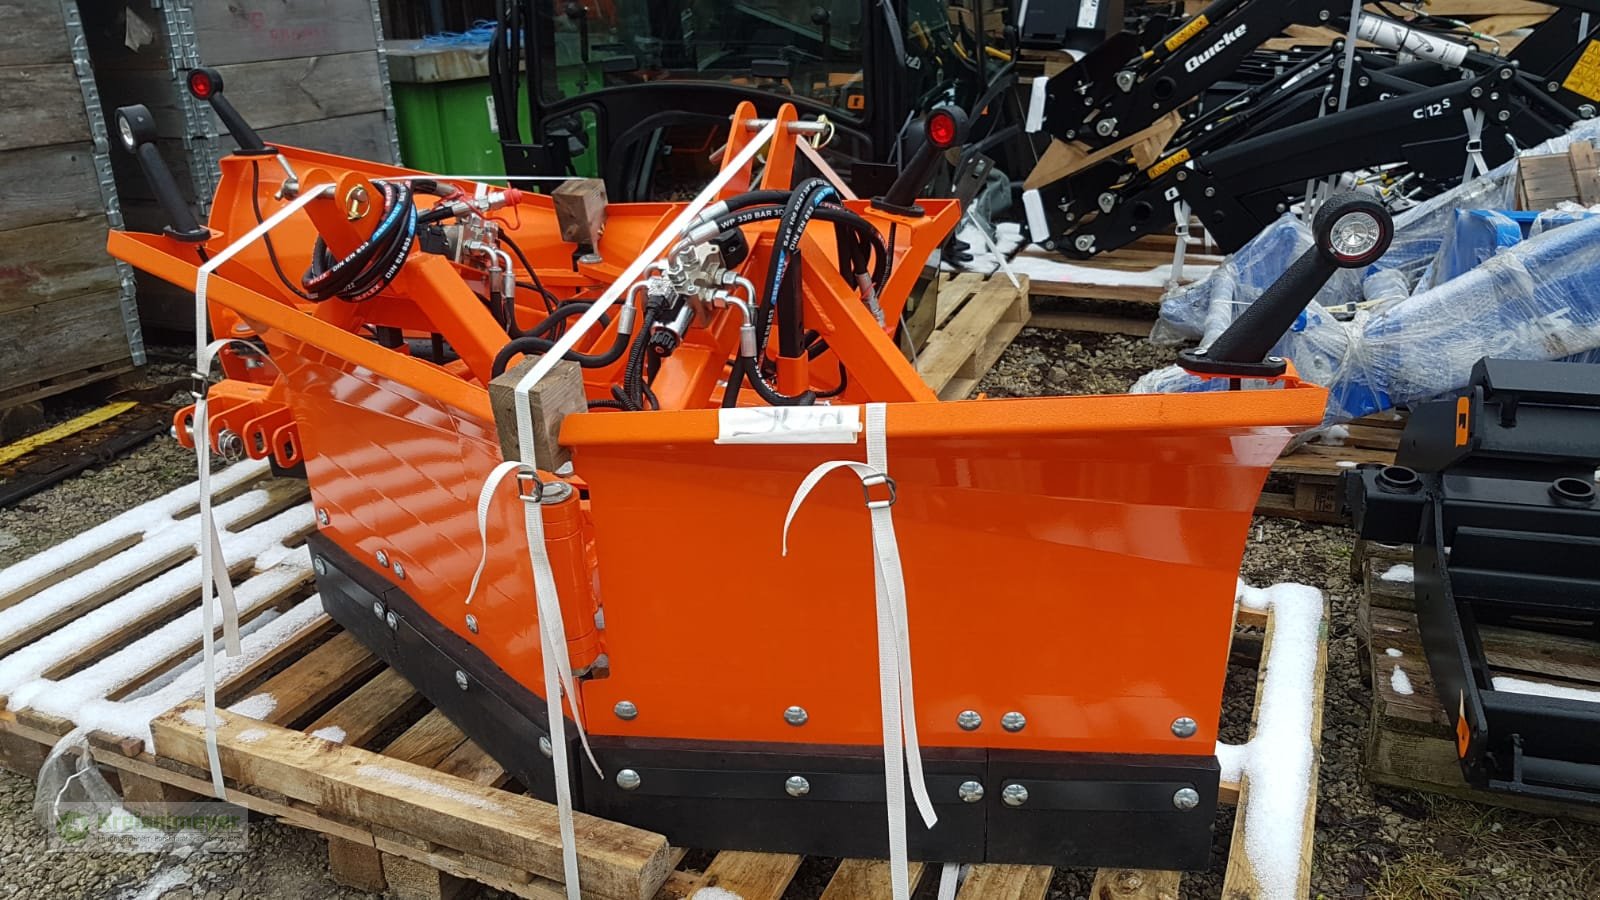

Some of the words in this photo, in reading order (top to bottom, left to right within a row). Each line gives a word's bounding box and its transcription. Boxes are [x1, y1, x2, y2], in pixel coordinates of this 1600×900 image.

[1185, 24, 1247, 73] Quicke
[720, 218, 736, 229] WP
[737, 213, 753, 223] 330
[754, 209, 773, 218] BAR
[789, 234, 799, 250] DIN
[797, 220, 806, 233] EN
[332, 261, 345, 272] DIN
[345, 252, 356, 263] EN
[385, 264, 398, 279] DIN
[395, 252, 405, 264] EN
[402, 237, 411, 251] 853
